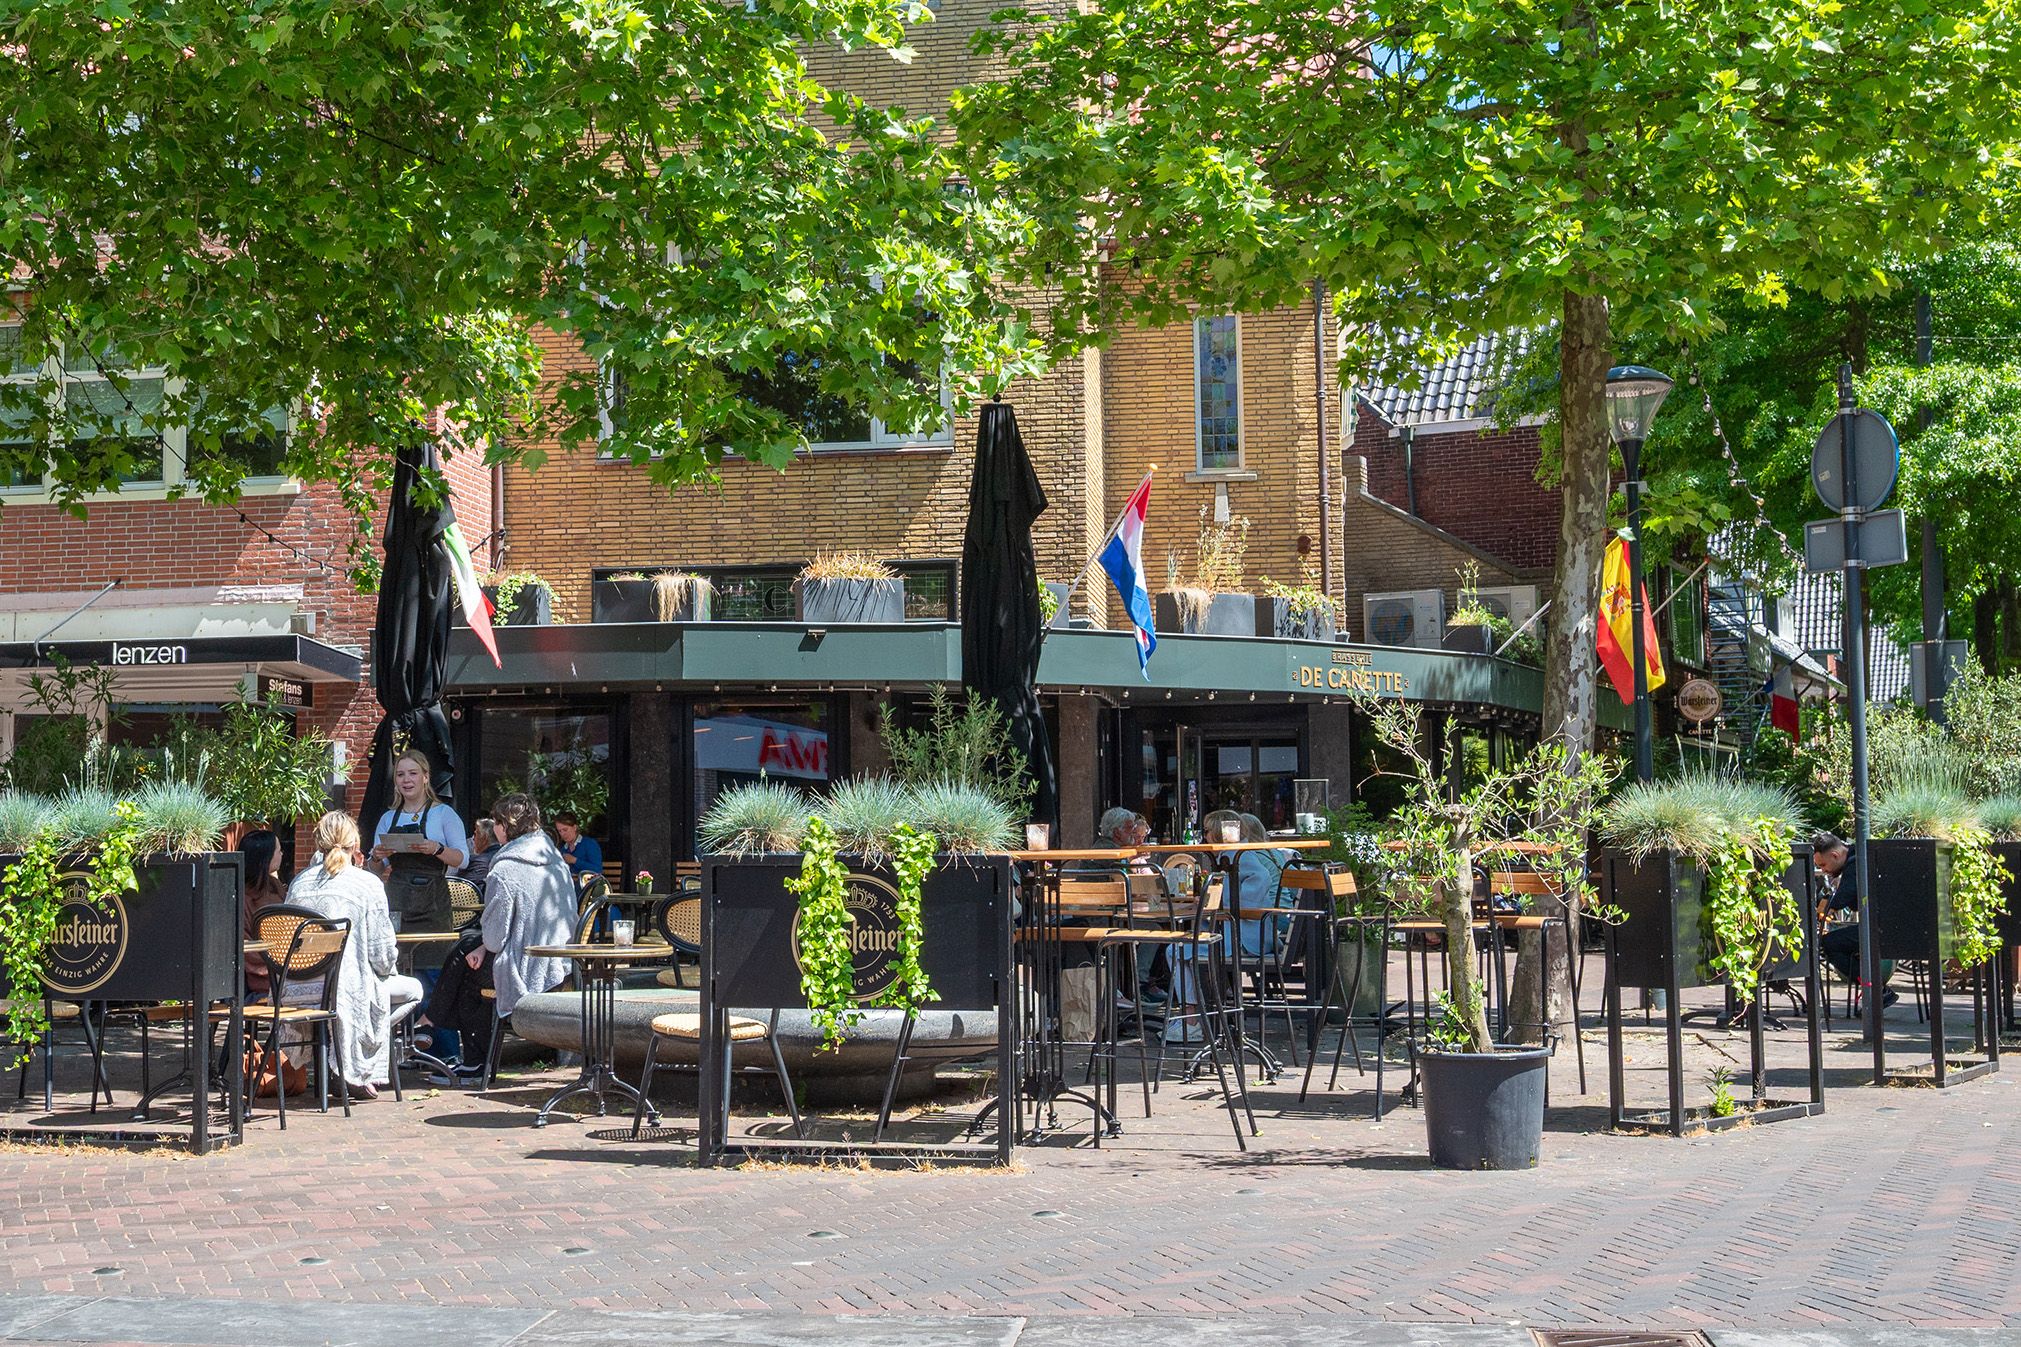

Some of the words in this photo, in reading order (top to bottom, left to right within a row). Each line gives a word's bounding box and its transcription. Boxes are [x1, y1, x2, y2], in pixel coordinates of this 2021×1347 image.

[112, 642, 187, 665] lenzen
[1331, 651, 1373, 664] BRASSERIE
[269, 678, 303, 696] Stefans
[1301, 666, 1323, 688] DE
[1328, 667, 1403, 692] CANETTE
[1681, 695, 1718, 707] Warsteiner
[880, 902, 896, 920] 1753
[49, 914, 118, 948] arsteiner
[54, 967, 83, 978] EINZIG
[84, 951, 109, 975] WAHRE
